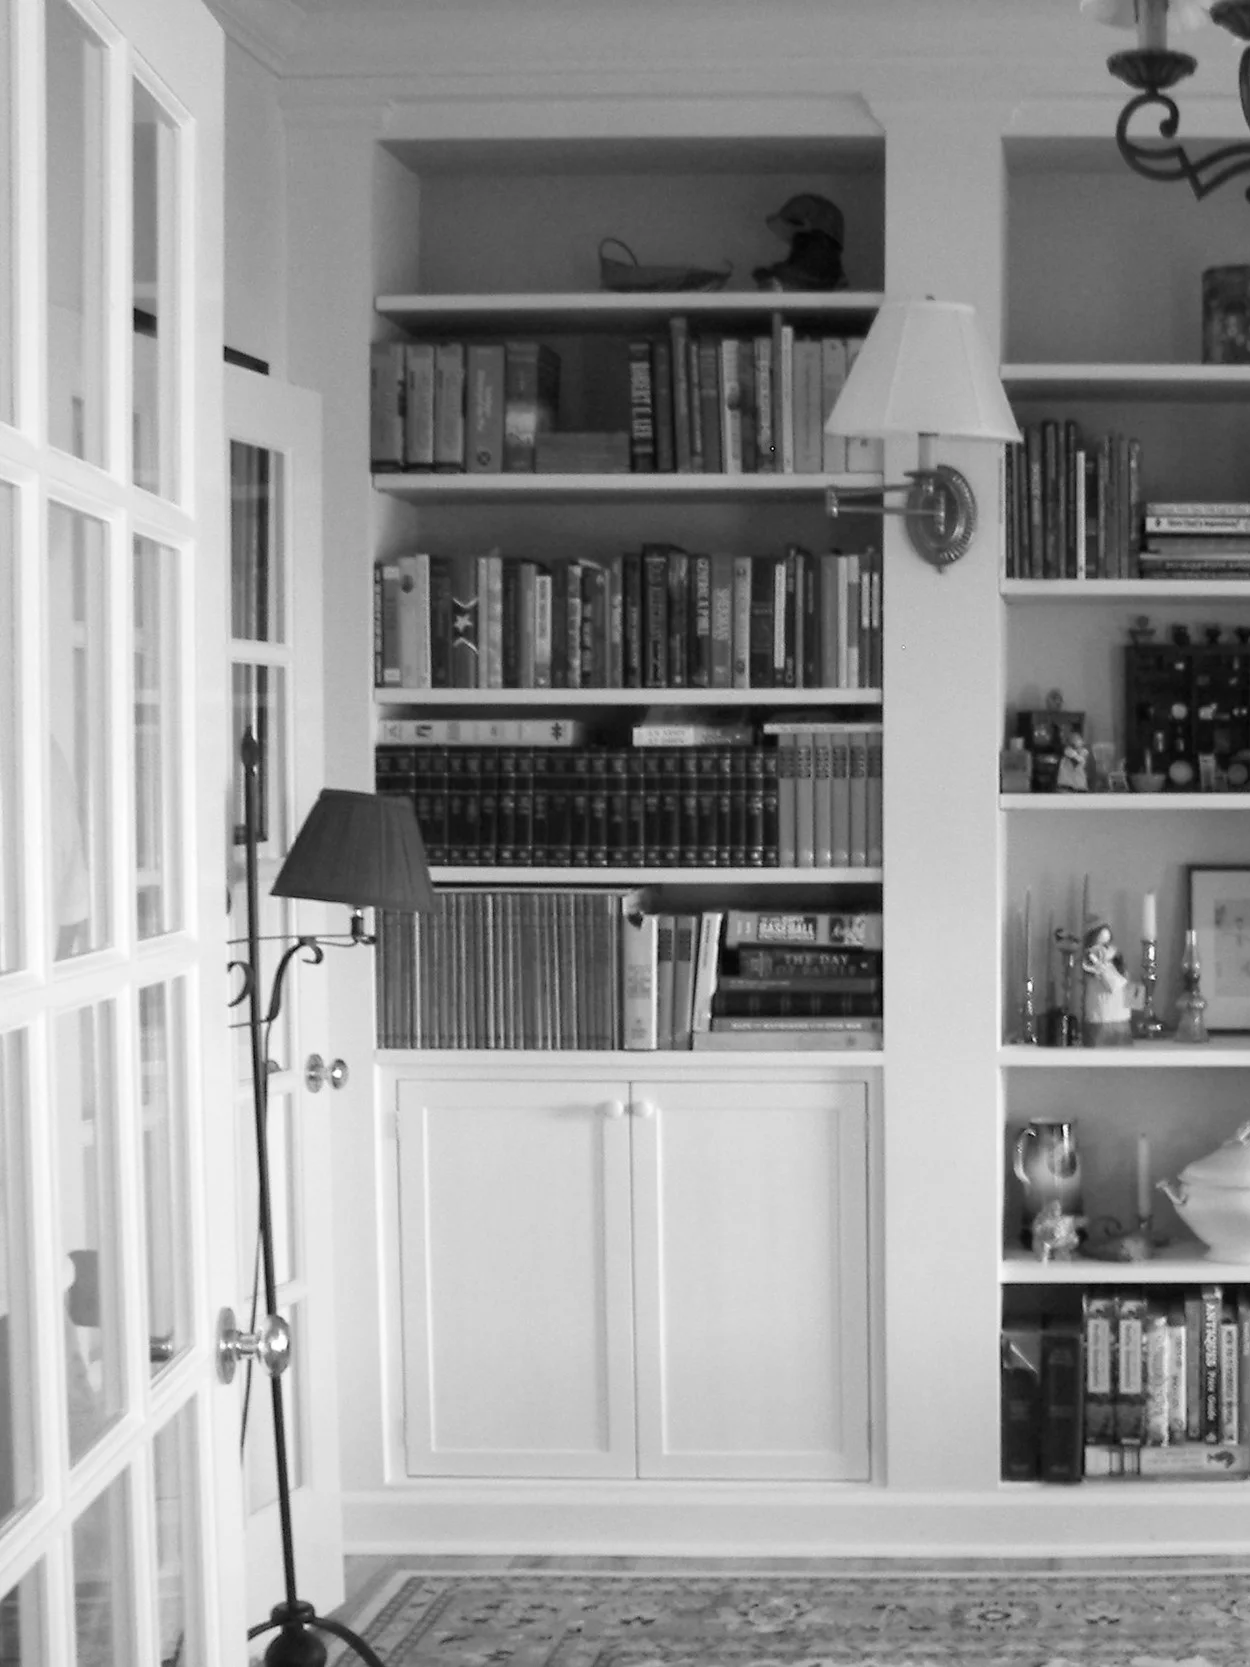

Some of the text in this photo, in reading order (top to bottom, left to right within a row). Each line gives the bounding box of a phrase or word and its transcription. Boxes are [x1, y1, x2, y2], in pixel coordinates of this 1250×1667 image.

[784, 953, 849, 966] THE DAY
[1204, 1302, 1218, 1421] ANTIQUES Price Guide
